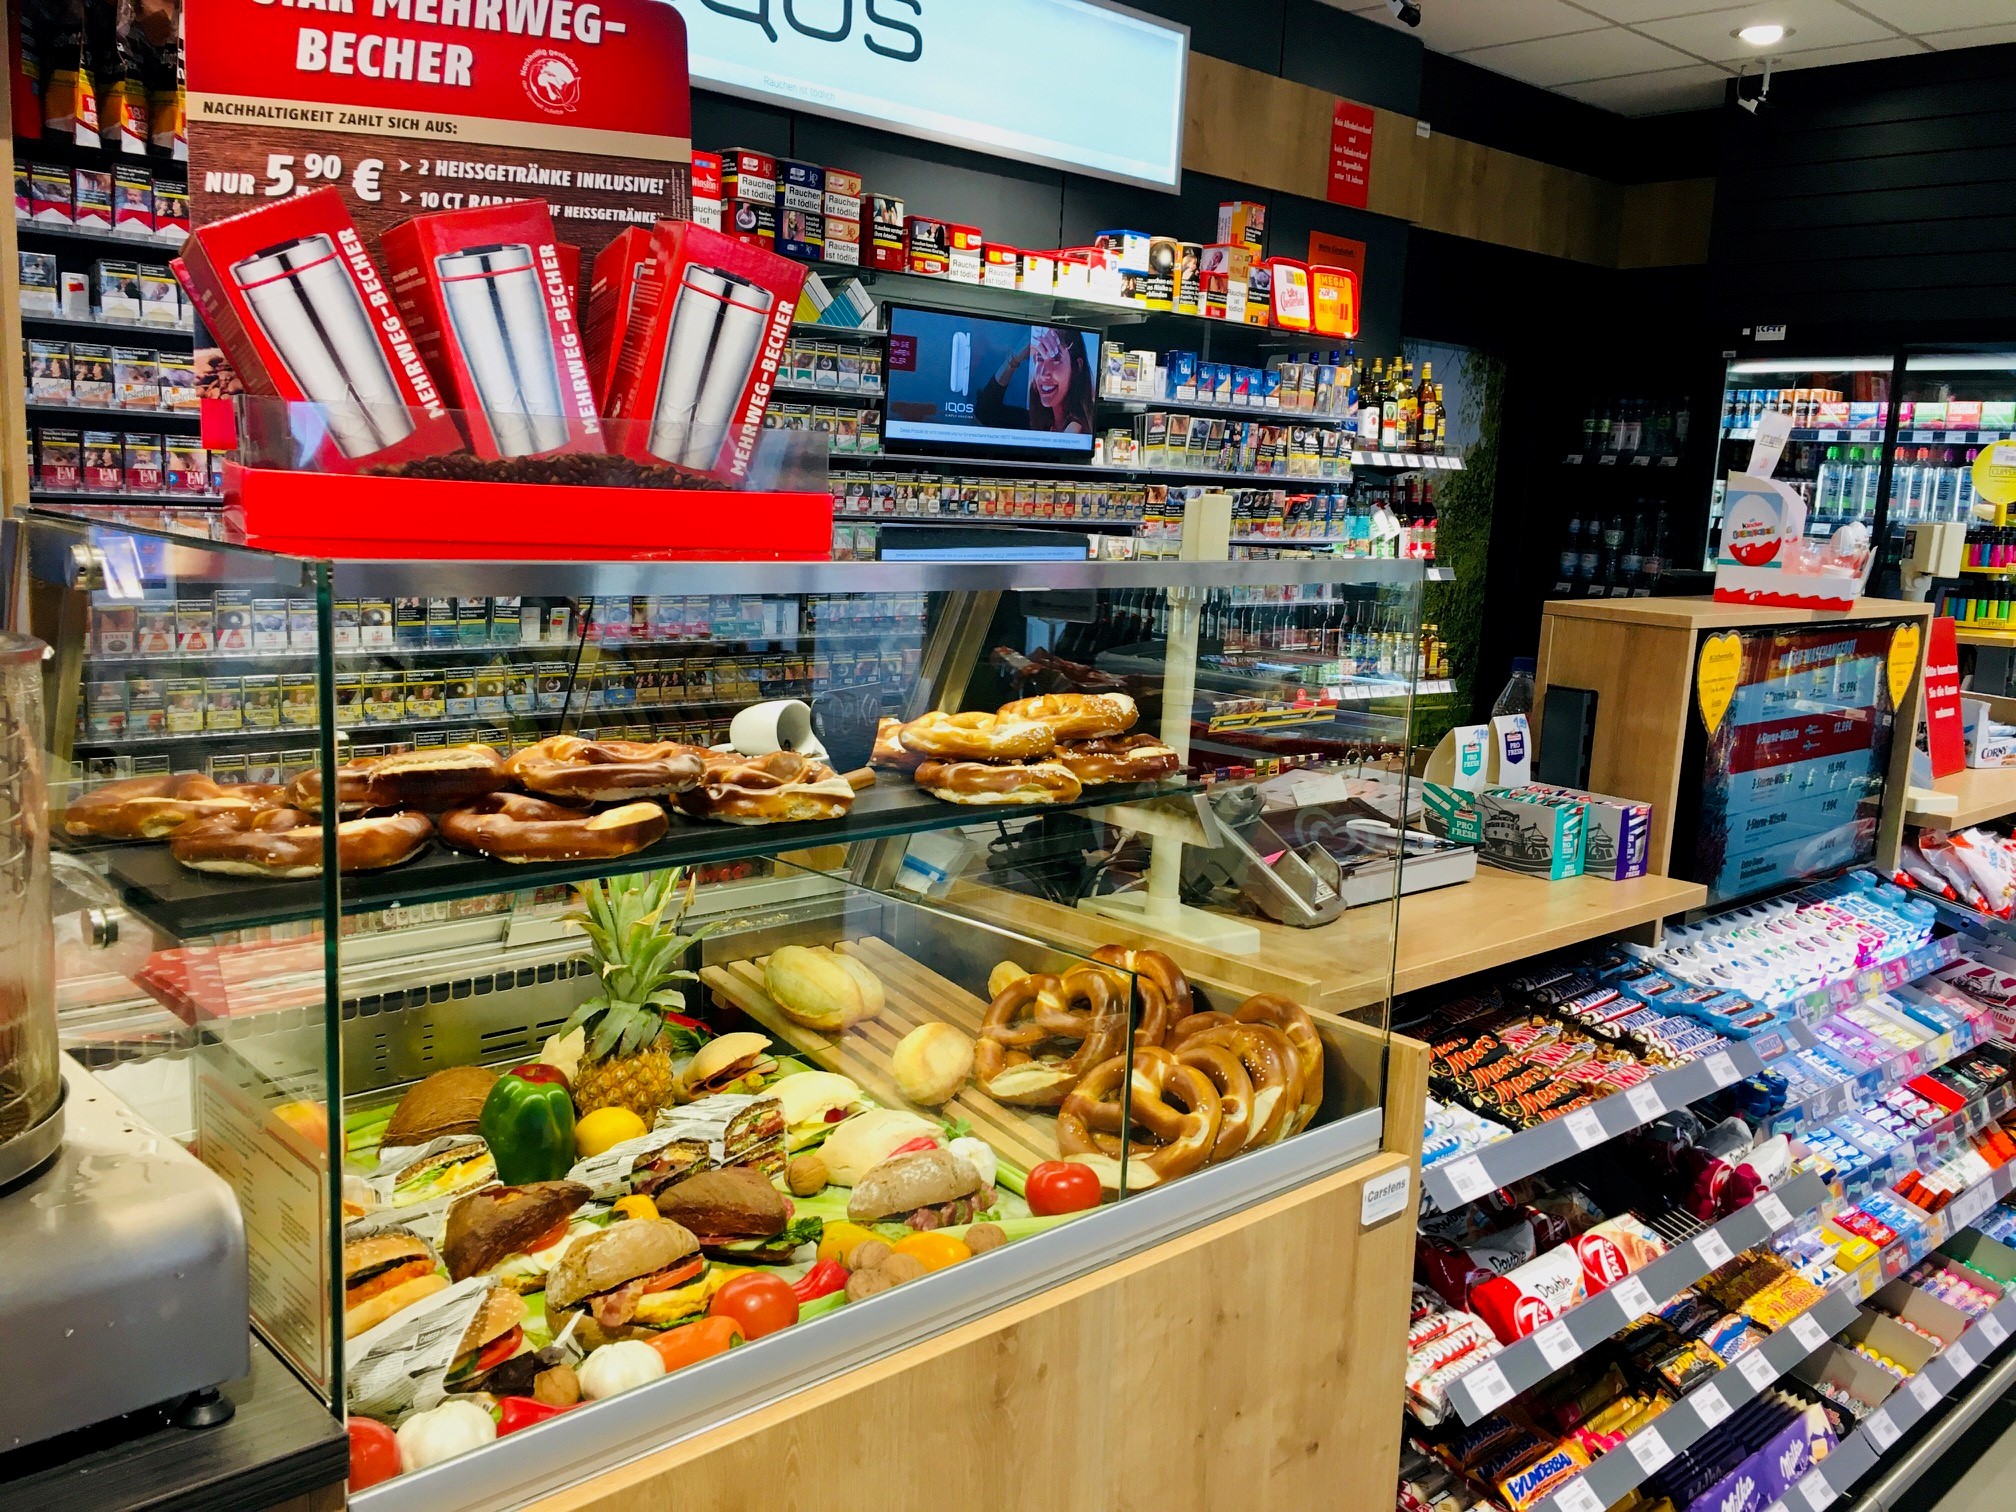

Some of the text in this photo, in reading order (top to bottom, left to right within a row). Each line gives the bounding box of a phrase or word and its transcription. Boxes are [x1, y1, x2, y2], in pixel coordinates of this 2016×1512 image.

[296, 28, 473, 86] BECHER
[763, 75, 798, 92] Rauchen
[203, 101, 458, 134] NACHHALTIGKEIT ZAHLT SICH AUS:
[205, 159, 385, 201] NUR €
[419, 160, 571, 187] 2 HEISSGETRÄNKE
[692, 175, 717, 189] Winston
[742, 177, 775, 191] Rauchen
[420, 192, 463, 210] 10 CT
[739, 188, 750, 197] ist
[786, 195, 797, 206] ist
[789, 187, 821, 200] Rauchen
[693, 205, 721, 215] auche
[826, 204, 835, 213] ist
[700, 216, 710, 225] ist
[826, 250, 835, 259] ist
[995, 276, 1013, 286] tödlic
[1321, 275, 1345, 288] MEGA
[337, 227, 445, 419] MEHRWEG-BECHER
[539, 243, 600, 435] MEHRWEG-BECHER
[730, 300, 795, 477] MEHRWEG-BECHER
[945, 402, 974, 414] IQOS
[1508, 748, 1523, 756] FRESH
[1451, 828, 1477, 840] FRESH
[1456, 820, 1473, 830] PRO
[1621, 1007, 1665, 1032] SNICKERS
[1652, 1016, 1696, 1039] SNICKERS
[1993, 1009, 2016, 1025] RIEND
[1673, 1028, 1717, 1053] SNICKERS
[1445, 1035, 1498, 1076] Mars
[1519, 1042, 1577, 1070] TWIX
[1469, 1054, 1522, 1091] Mars
[1492, 1067, 1546, 1104] Mars
[1515, 1080, 1571, 1117] Mars
[1368, 1179, 1406, 1203] Carstens
[1489, 1250, 1526, 1272] Double
[1603, 1240, 1624, 1278] DAYS
[1535, 1275, 1573, 1299] Double
[1420, 1326, 1477, 1368] BOUNTY
[1780, 1439, 1804, 1481] Milka
